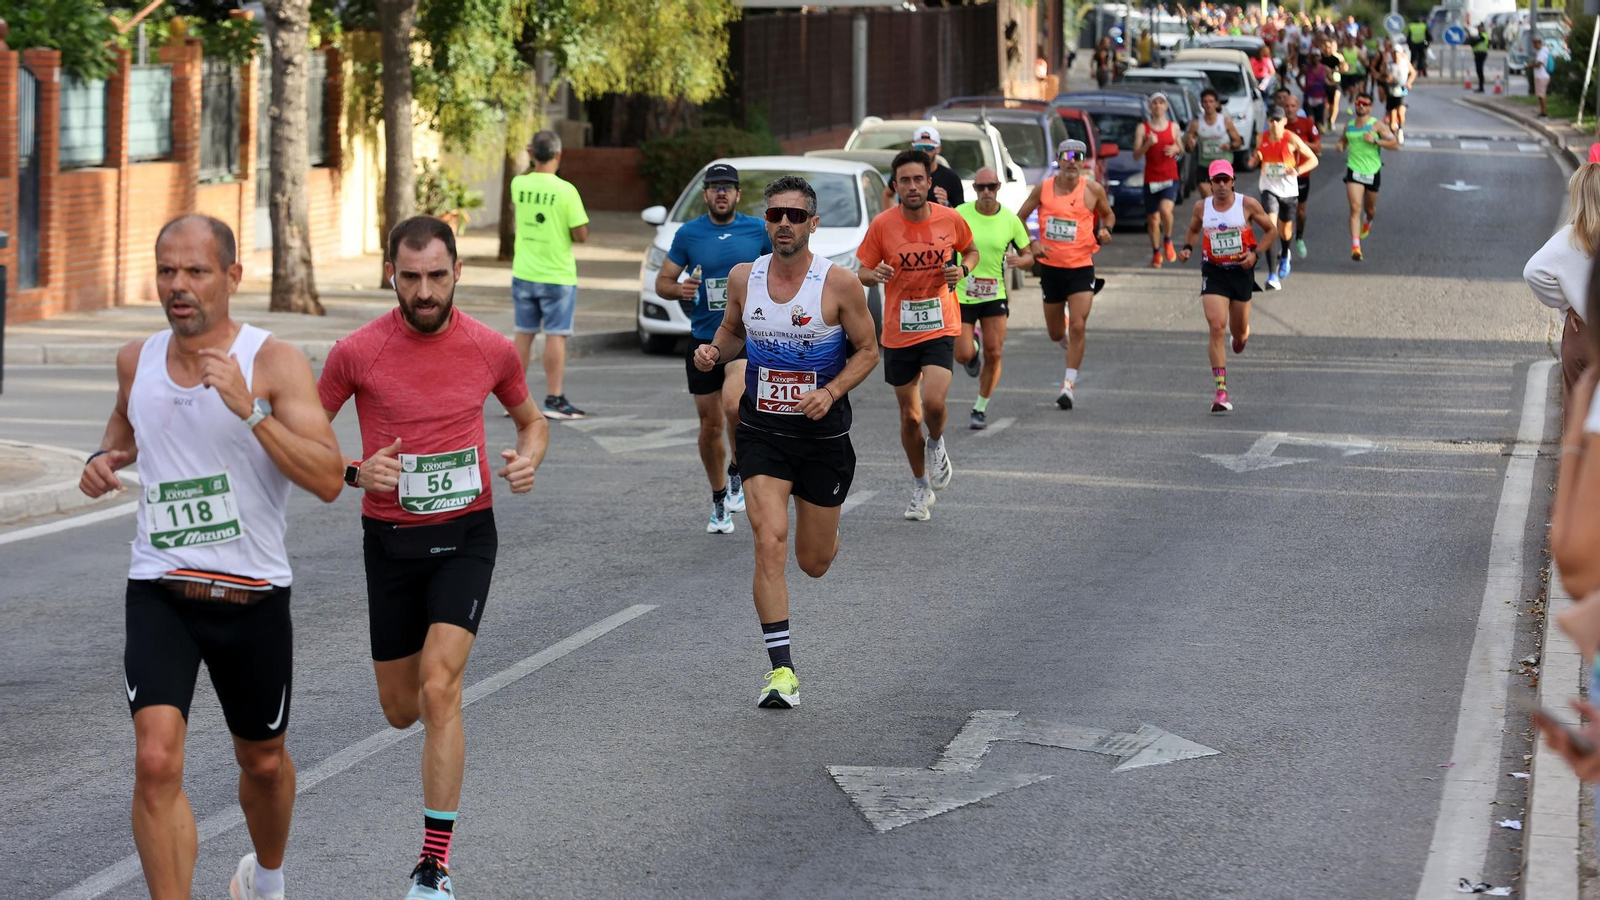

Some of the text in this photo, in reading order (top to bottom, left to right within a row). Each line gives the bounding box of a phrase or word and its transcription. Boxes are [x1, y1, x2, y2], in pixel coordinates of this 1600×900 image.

[519, 191, 556, 206] STAFF
[1218, 239, 1234, 248] 113
[975, 285, 992, 293] 298
[914, 311, 929, 322] 13
[770, 384, 800, 400] 210
[427, 472, 452, 493] 56
[166, 501, 213, 527] 118
